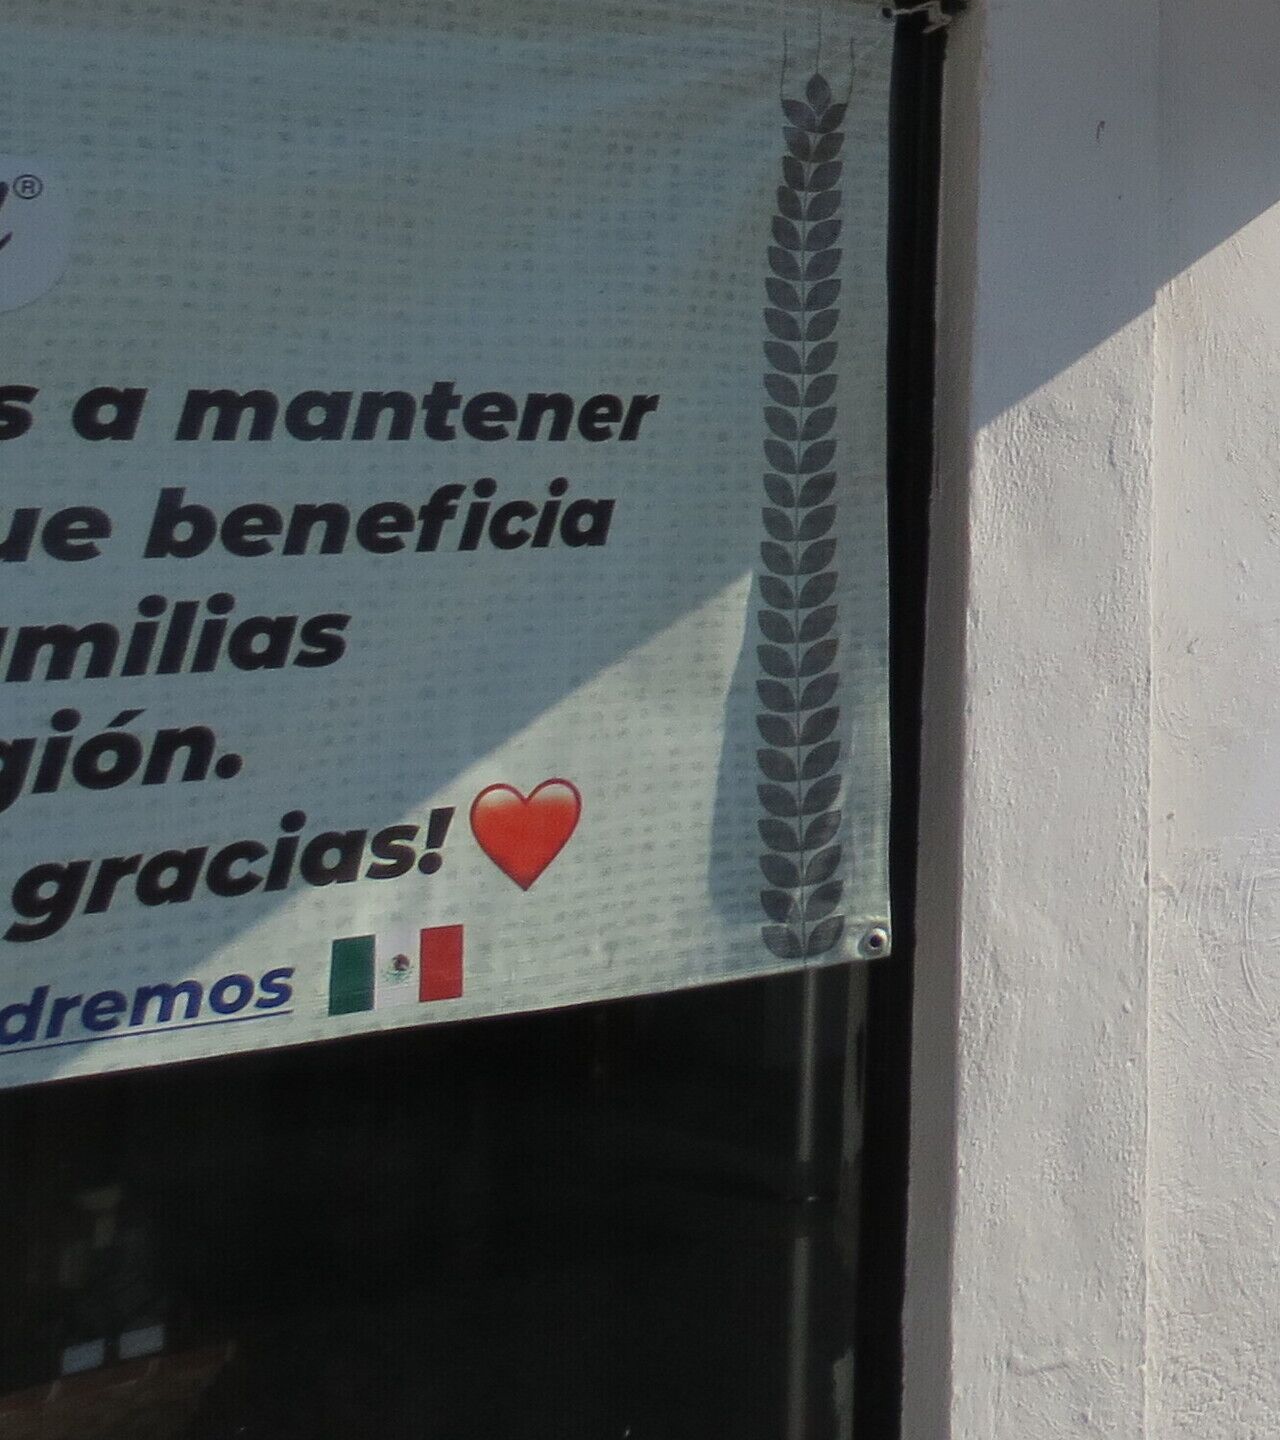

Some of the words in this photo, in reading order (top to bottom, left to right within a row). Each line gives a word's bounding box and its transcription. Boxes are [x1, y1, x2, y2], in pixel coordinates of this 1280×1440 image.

[72, 386, 149, 442] a
[175, 381, 660, 442] mantener
[144, 478, 615, 559] beneficia
[0, 592, 353, 682] milias
[3, 807, 455, 943] gracias!
[0, 967, 296, 1047] dremos
